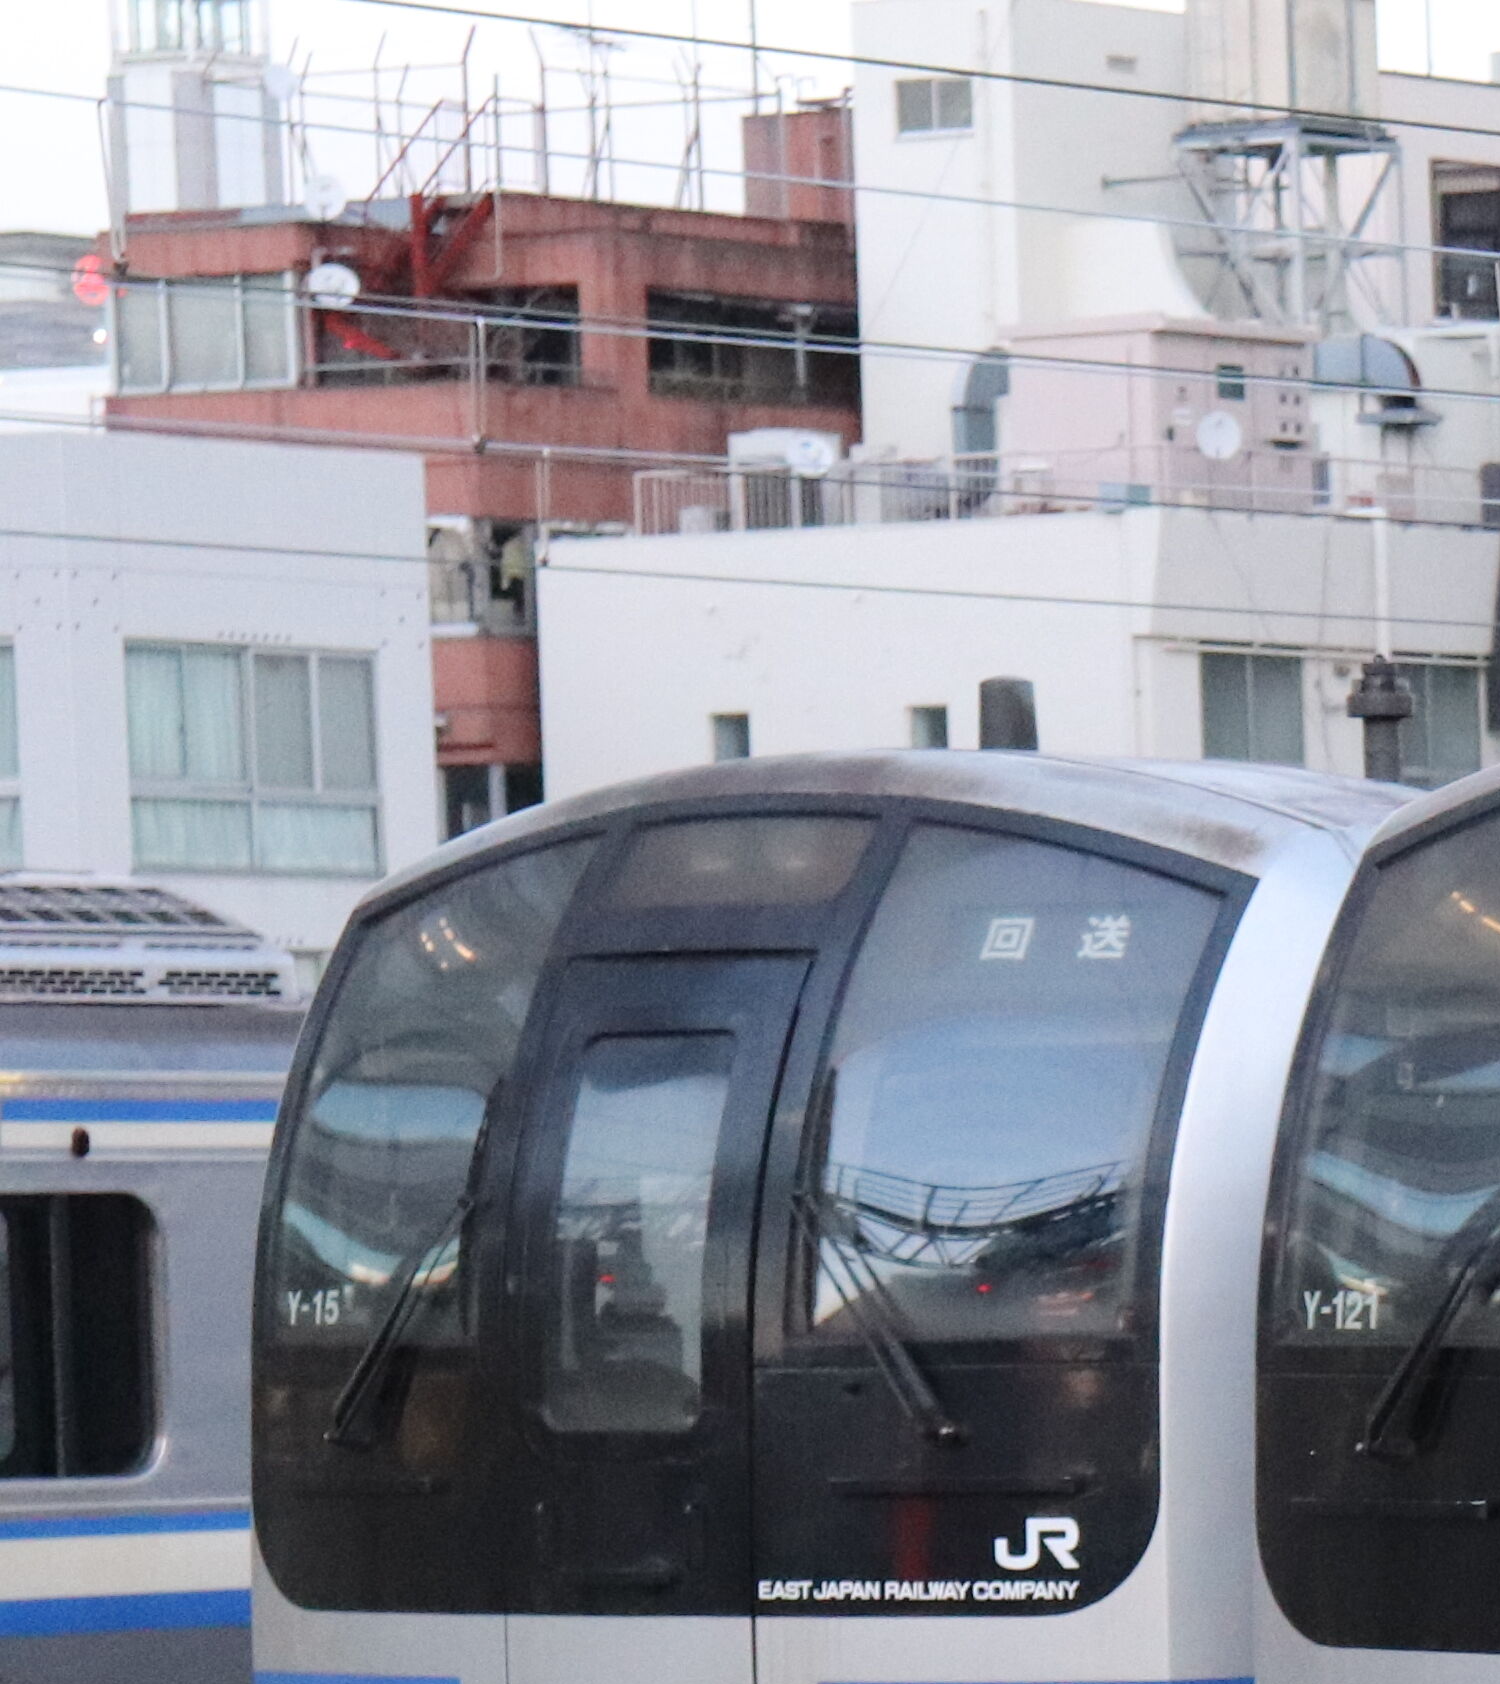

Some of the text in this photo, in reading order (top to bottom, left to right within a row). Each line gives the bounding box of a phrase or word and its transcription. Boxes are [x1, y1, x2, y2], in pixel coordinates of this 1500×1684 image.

[979, 914, 1131, 960] 回送
[288, 1289, 340, 1326] Y-15
[1303, 1290, 1378, 1330] Y-121
[994, 1516, 1080, 1571] JR
[758, 1579, 1079, 1600] EAST JAPAN RAILWAY COMPANY
